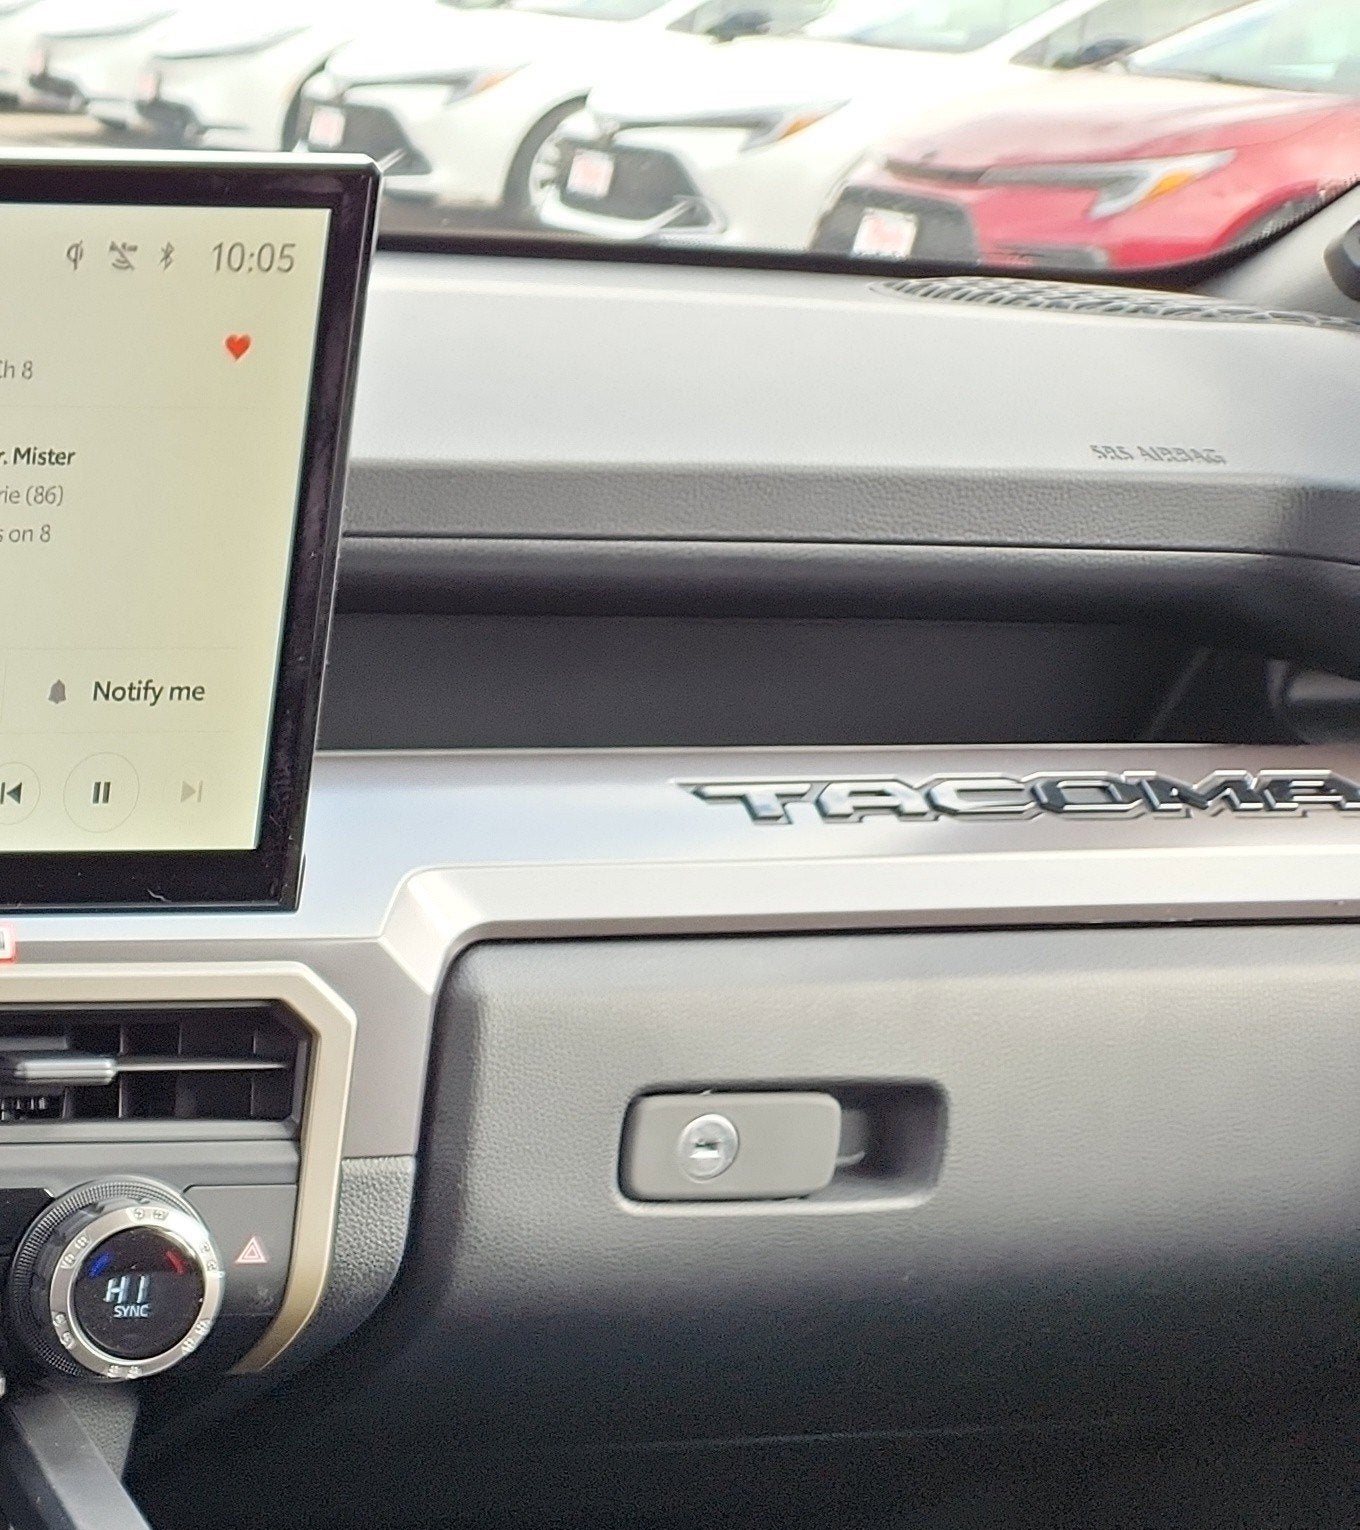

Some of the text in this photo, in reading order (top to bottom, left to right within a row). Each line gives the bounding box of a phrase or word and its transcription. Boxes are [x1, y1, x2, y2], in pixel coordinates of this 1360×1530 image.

[210, 242, 297, 274] 10:05
[21, 361, 35, 381] 8
[12, 446, 76, 467] Mister
[25, 484, 64, 508] (86)
[9, 526, 35, 543] on
[39, 524, 51, 543] 8
[92, 680, 206, 705] Notify me
[670, 768, 1360, 824] TACOMA
[113, 1304, 149, 1318] SYNC
